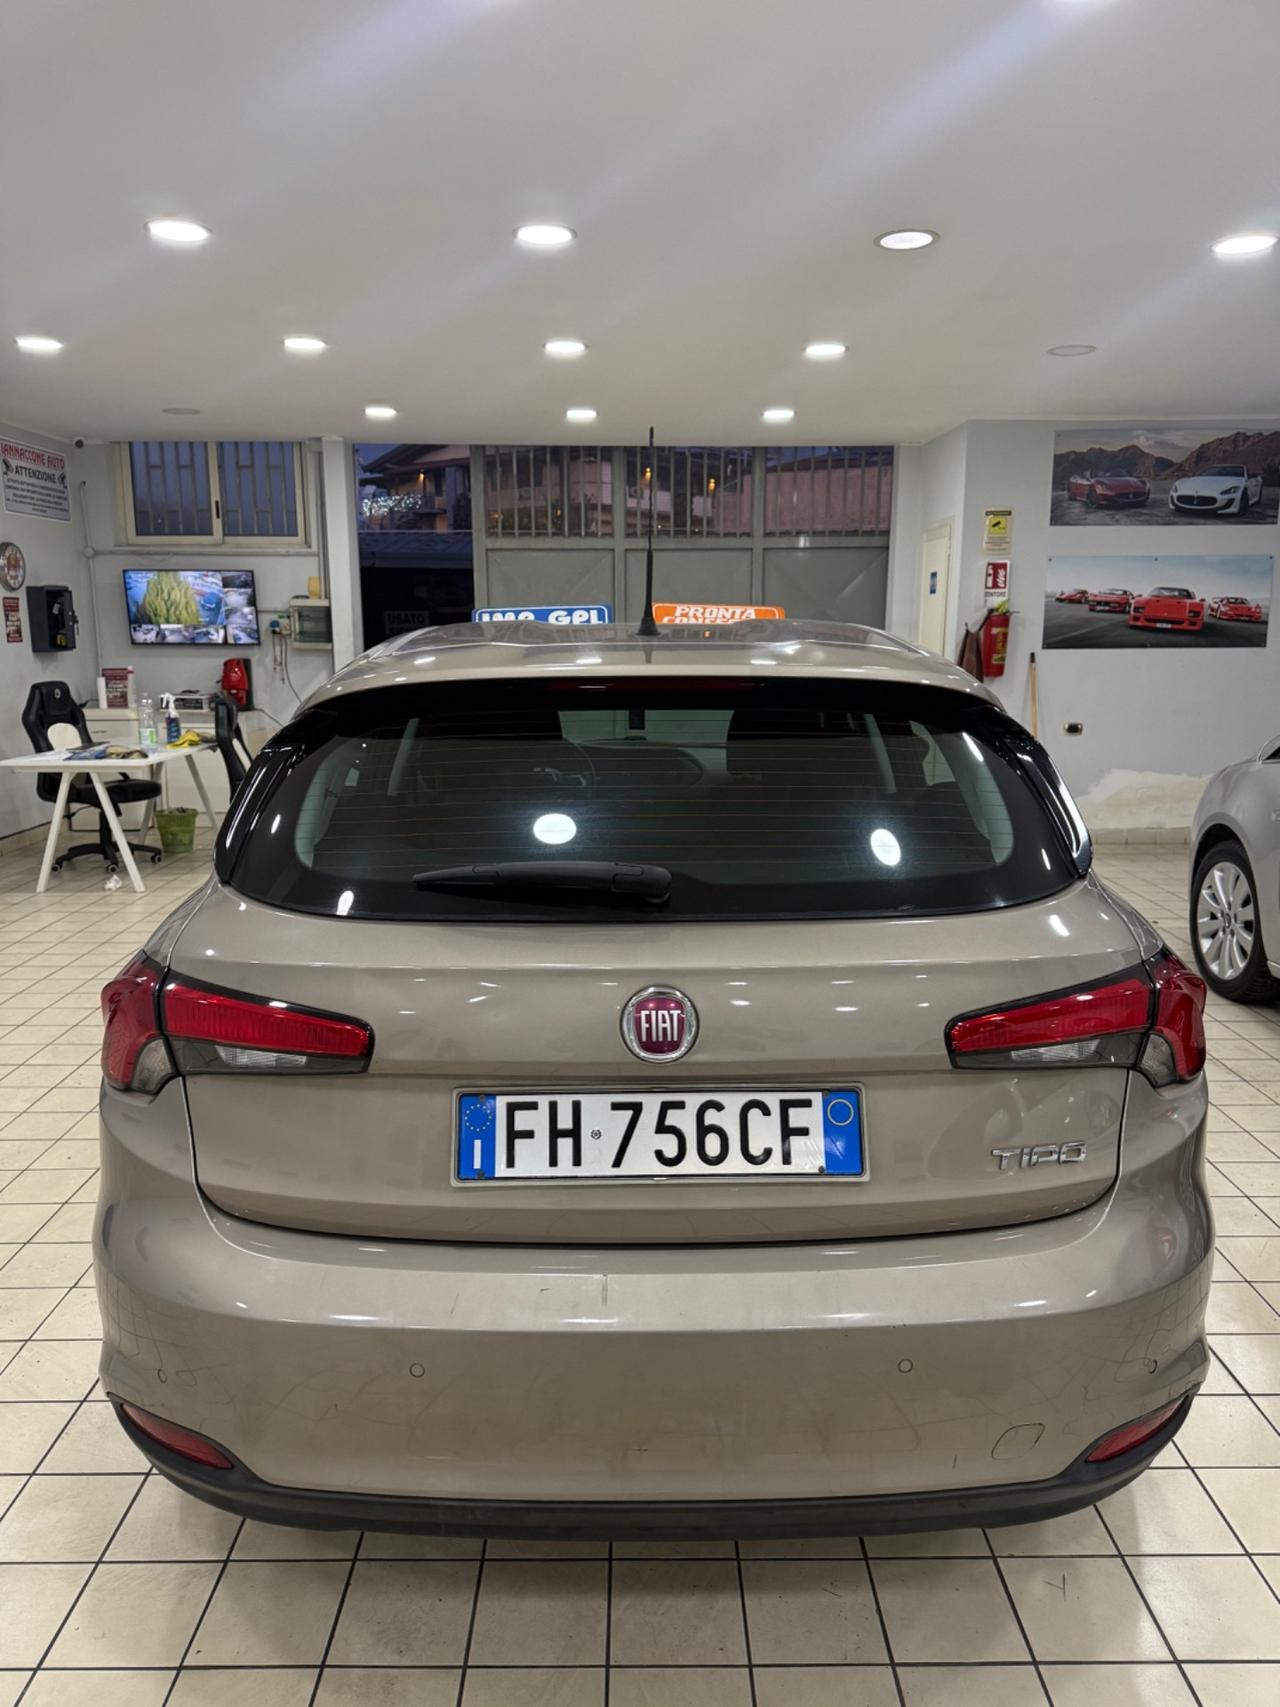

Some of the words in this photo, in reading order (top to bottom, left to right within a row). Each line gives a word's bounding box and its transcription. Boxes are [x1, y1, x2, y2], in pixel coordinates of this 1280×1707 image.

[15, 465, 57, 483] ATTENZIONE
[387, 613, 425, 625] USATO
[548, 609, 604, 625] GPL
[674, 605, 756, 619] PRONTA
[640, 1009, 682, 1042] FIAT
[991, 1141, 1087, 1169] TIPO
